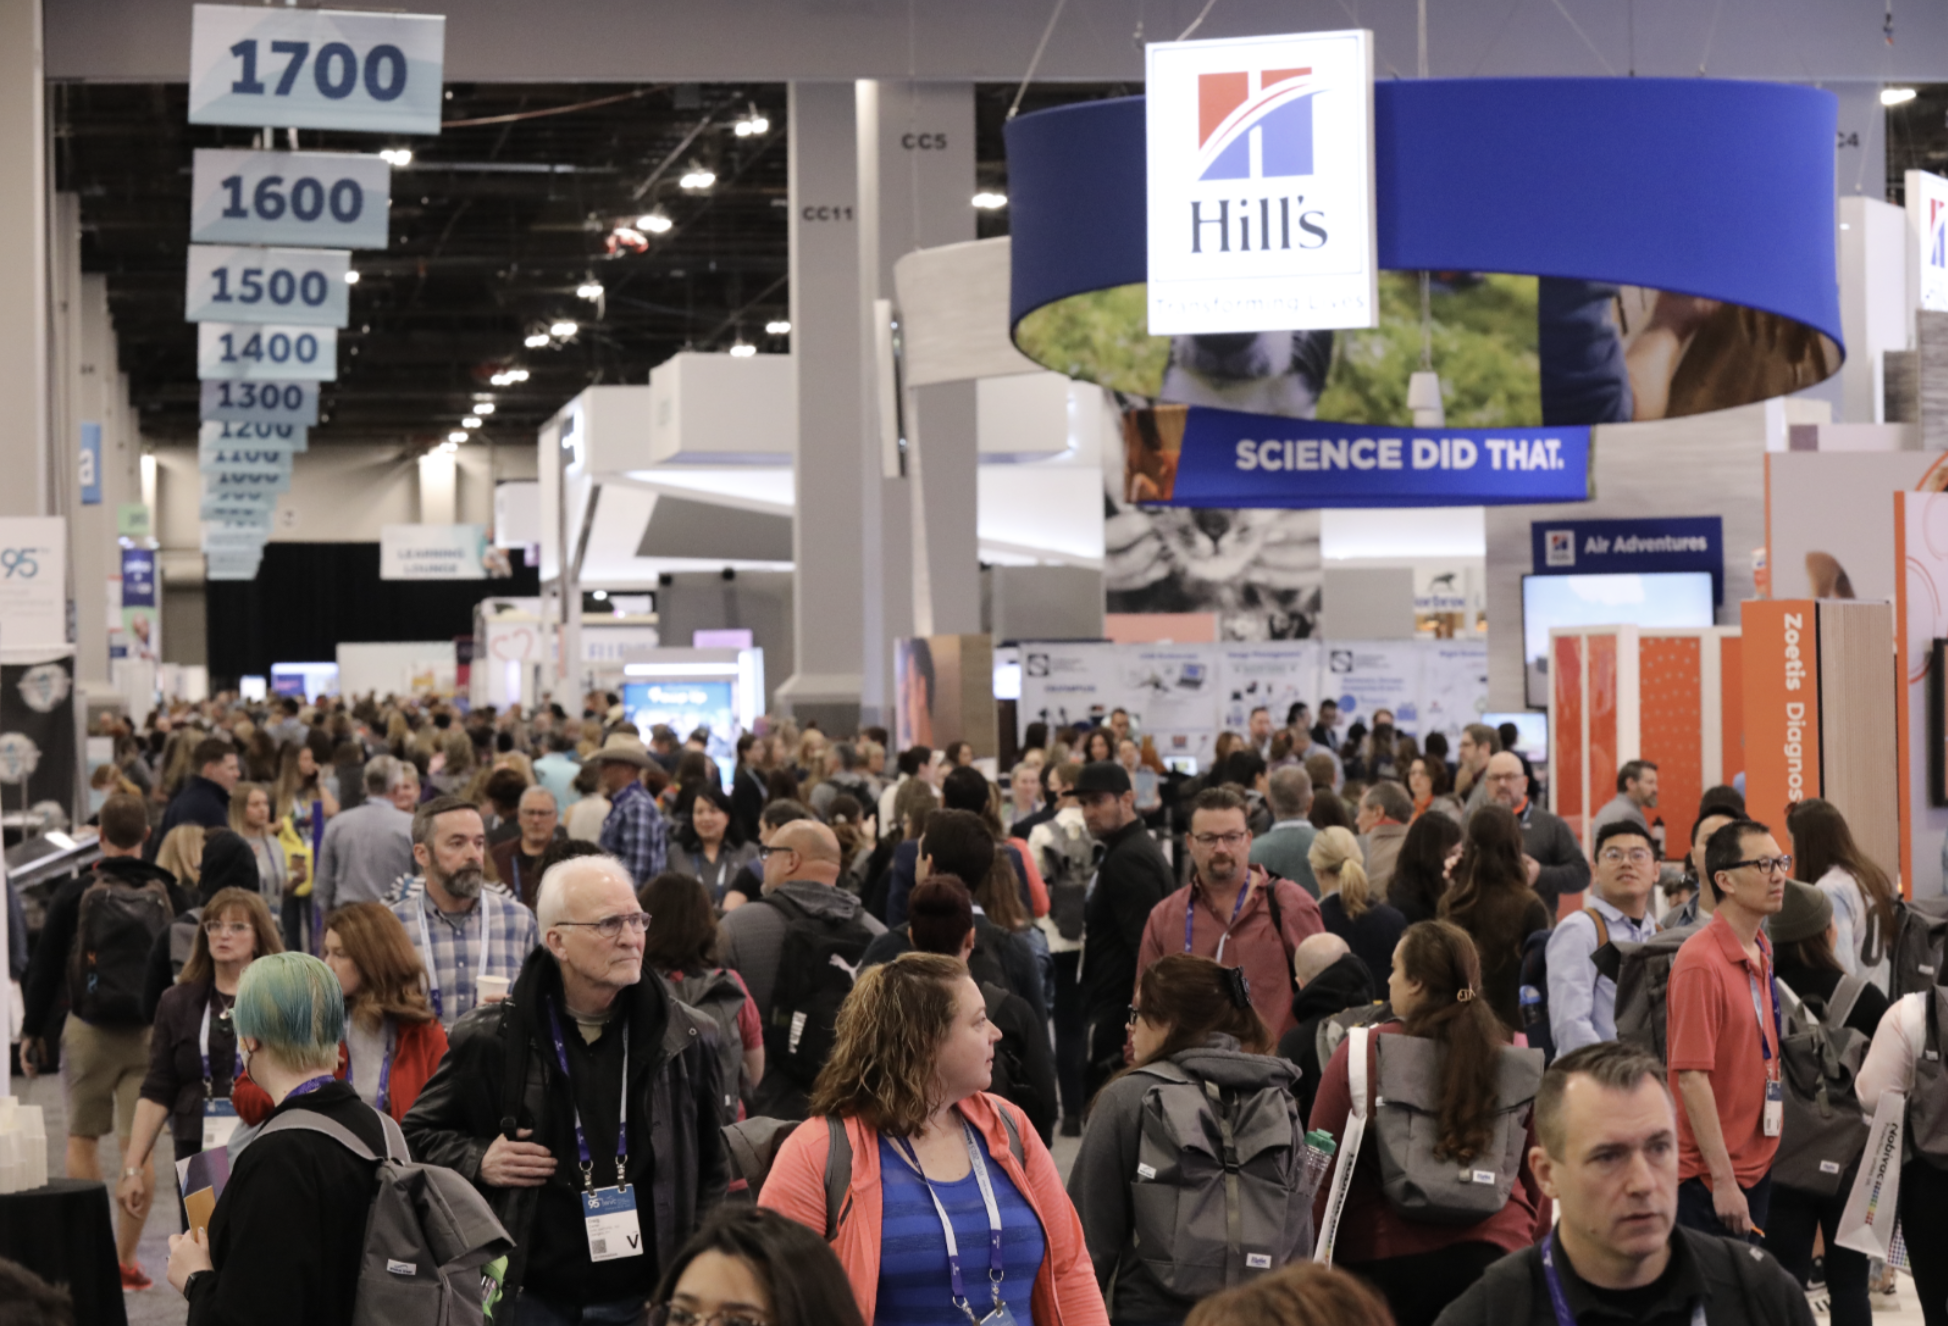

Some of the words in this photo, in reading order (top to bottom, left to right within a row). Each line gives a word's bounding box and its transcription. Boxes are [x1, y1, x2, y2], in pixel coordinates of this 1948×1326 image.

[229, 38, 408, 101] 1700
[901, 132, 948, 150] CC5
[220, 175, 364, 223] 1600
[802, 206, 854, 221] CC11
[1190, 195, 1328, 253] Hill's
[210, 266, 328, 307] 1500
[218, 332, 318, 364] 1400
[217, 381, 304, 410] 1300
[1235, 438, 1403, 471] SCIENCE
[1411, 438, 1478, 470] DID
[1484, 438, 1565, 471] THAT.
[1584, 535, 1611, 554] Air
[1613, 535, 1708, 553] Adventures
[1783, 612, 1806, 691] Zoetis
[1876, 1122, 1899, 1180] Nobivac
[626, 1233, 639, 1250] V
